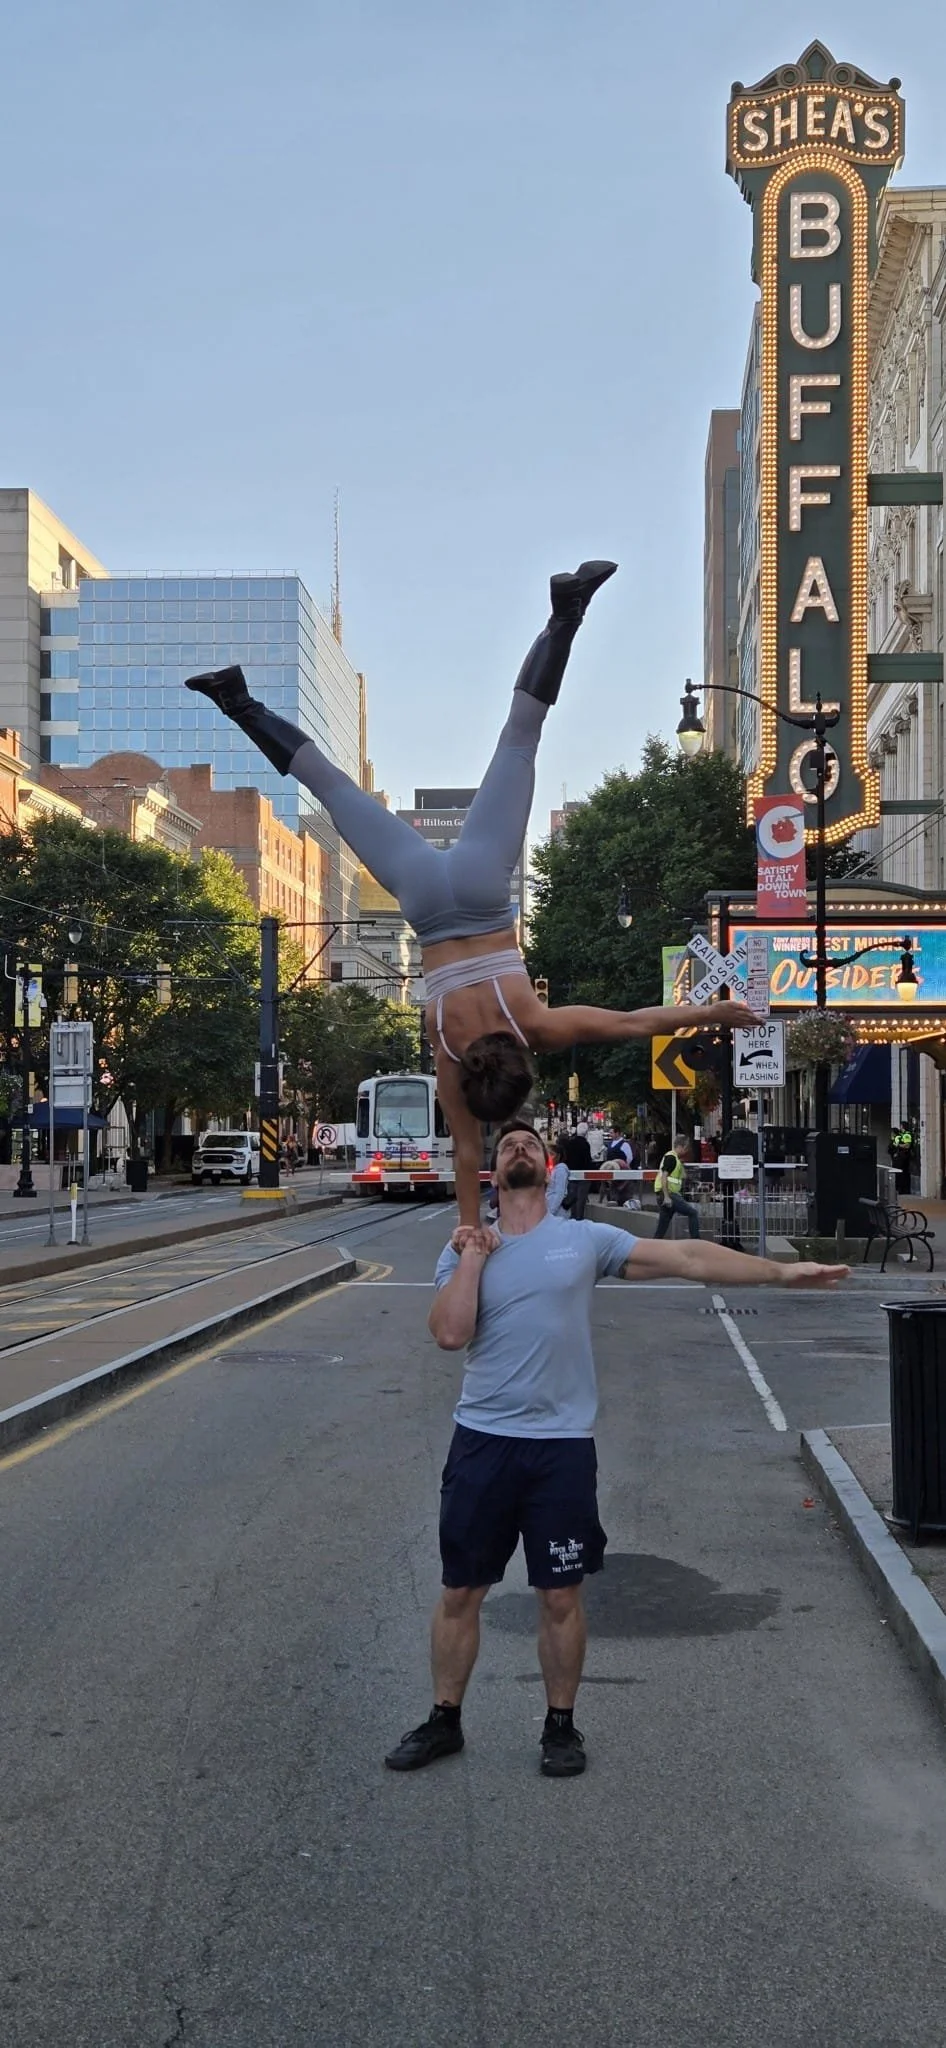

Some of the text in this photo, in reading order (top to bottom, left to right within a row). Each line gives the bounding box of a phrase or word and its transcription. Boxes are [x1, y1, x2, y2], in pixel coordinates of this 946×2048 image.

[743, 94, 890, 151] SHEA'S
[789, 191, 842, 804] BUFFALO
[423, 818, 453, 827] Hilton
[757, 864, 799, 876] SATISFY
[765, 873, 795, 883] IT ALL
[757, 882, 790, 892] DOWN
[775, 888, 807, 899] TOWN
[691, 937, 748, 999] RAIL ROA
[694, 940, 748, 1000] CROSSIN
[770, 958, 925, 995] OUSIDER
[742, 1025, 776, 1039] STOP
[748, 1040, 770, 1049] HERE
[756, 1061, 779, 1070] WHEN
[740, 1072, 780, 1081] FLASHING
